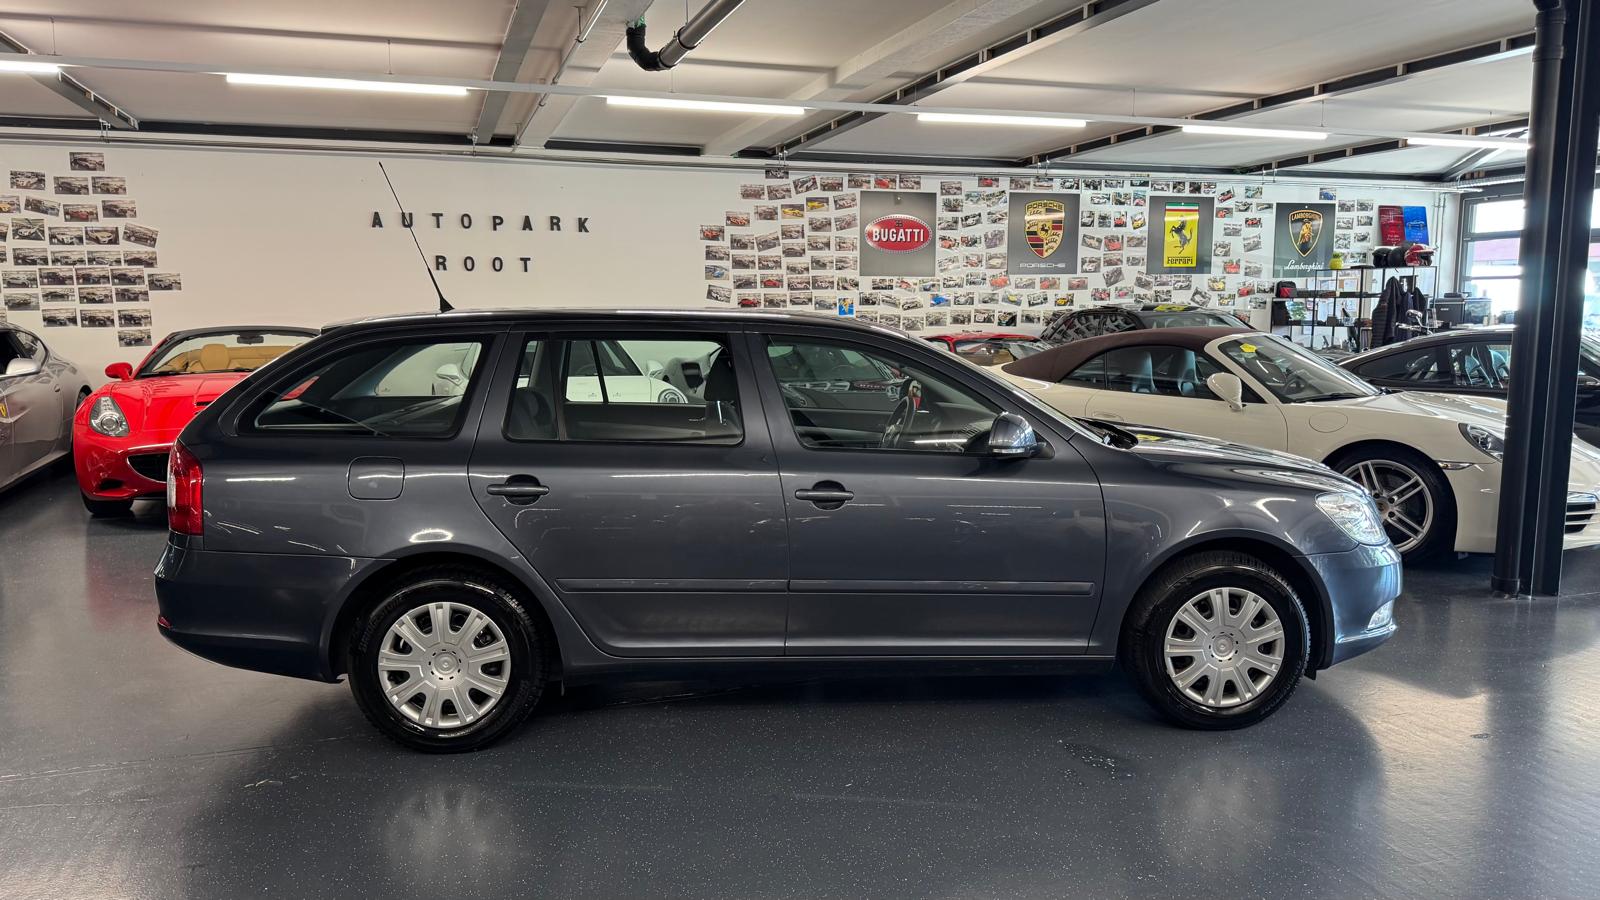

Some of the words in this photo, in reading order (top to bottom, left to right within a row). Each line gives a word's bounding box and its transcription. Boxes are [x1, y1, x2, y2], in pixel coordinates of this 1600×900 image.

[1026, 201, 1063, 211] PORSCHE
[371, 211, 590, 233] AUTOPARK
[872, 228, 924, 242] BUGATTI
[435, 255, 531, 273] ROOT
[1167, 256, 1193, 265] Ferrari
[1284, 259, 1324, 272] Lamborghini
